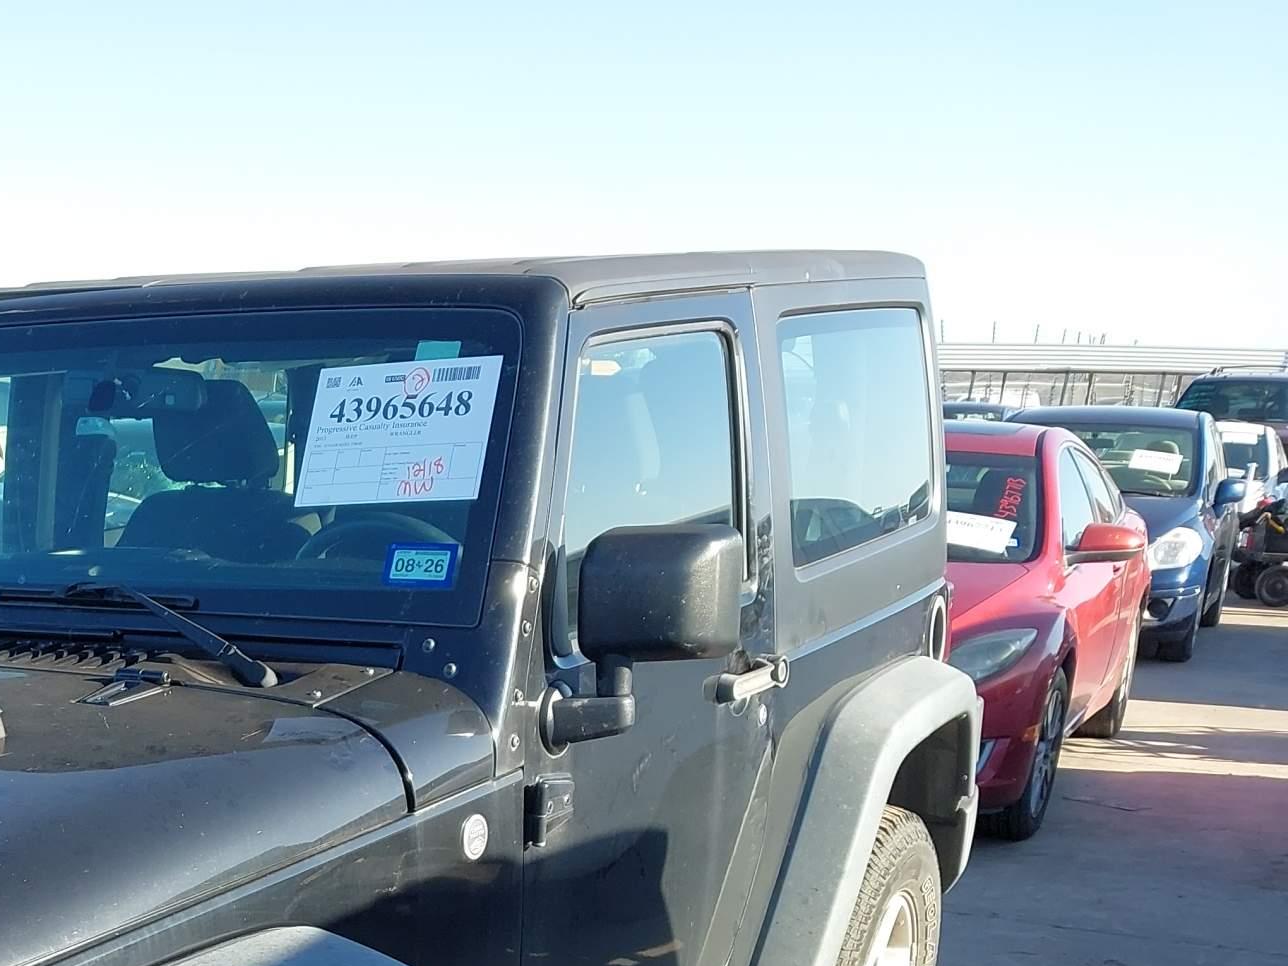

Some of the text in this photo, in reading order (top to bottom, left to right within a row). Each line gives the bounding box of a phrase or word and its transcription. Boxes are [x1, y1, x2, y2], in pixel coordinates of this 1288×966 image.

[330, 390, 473, 423] 43965648
[316, 420, 428, 434] Progressive Casualty Insurance
